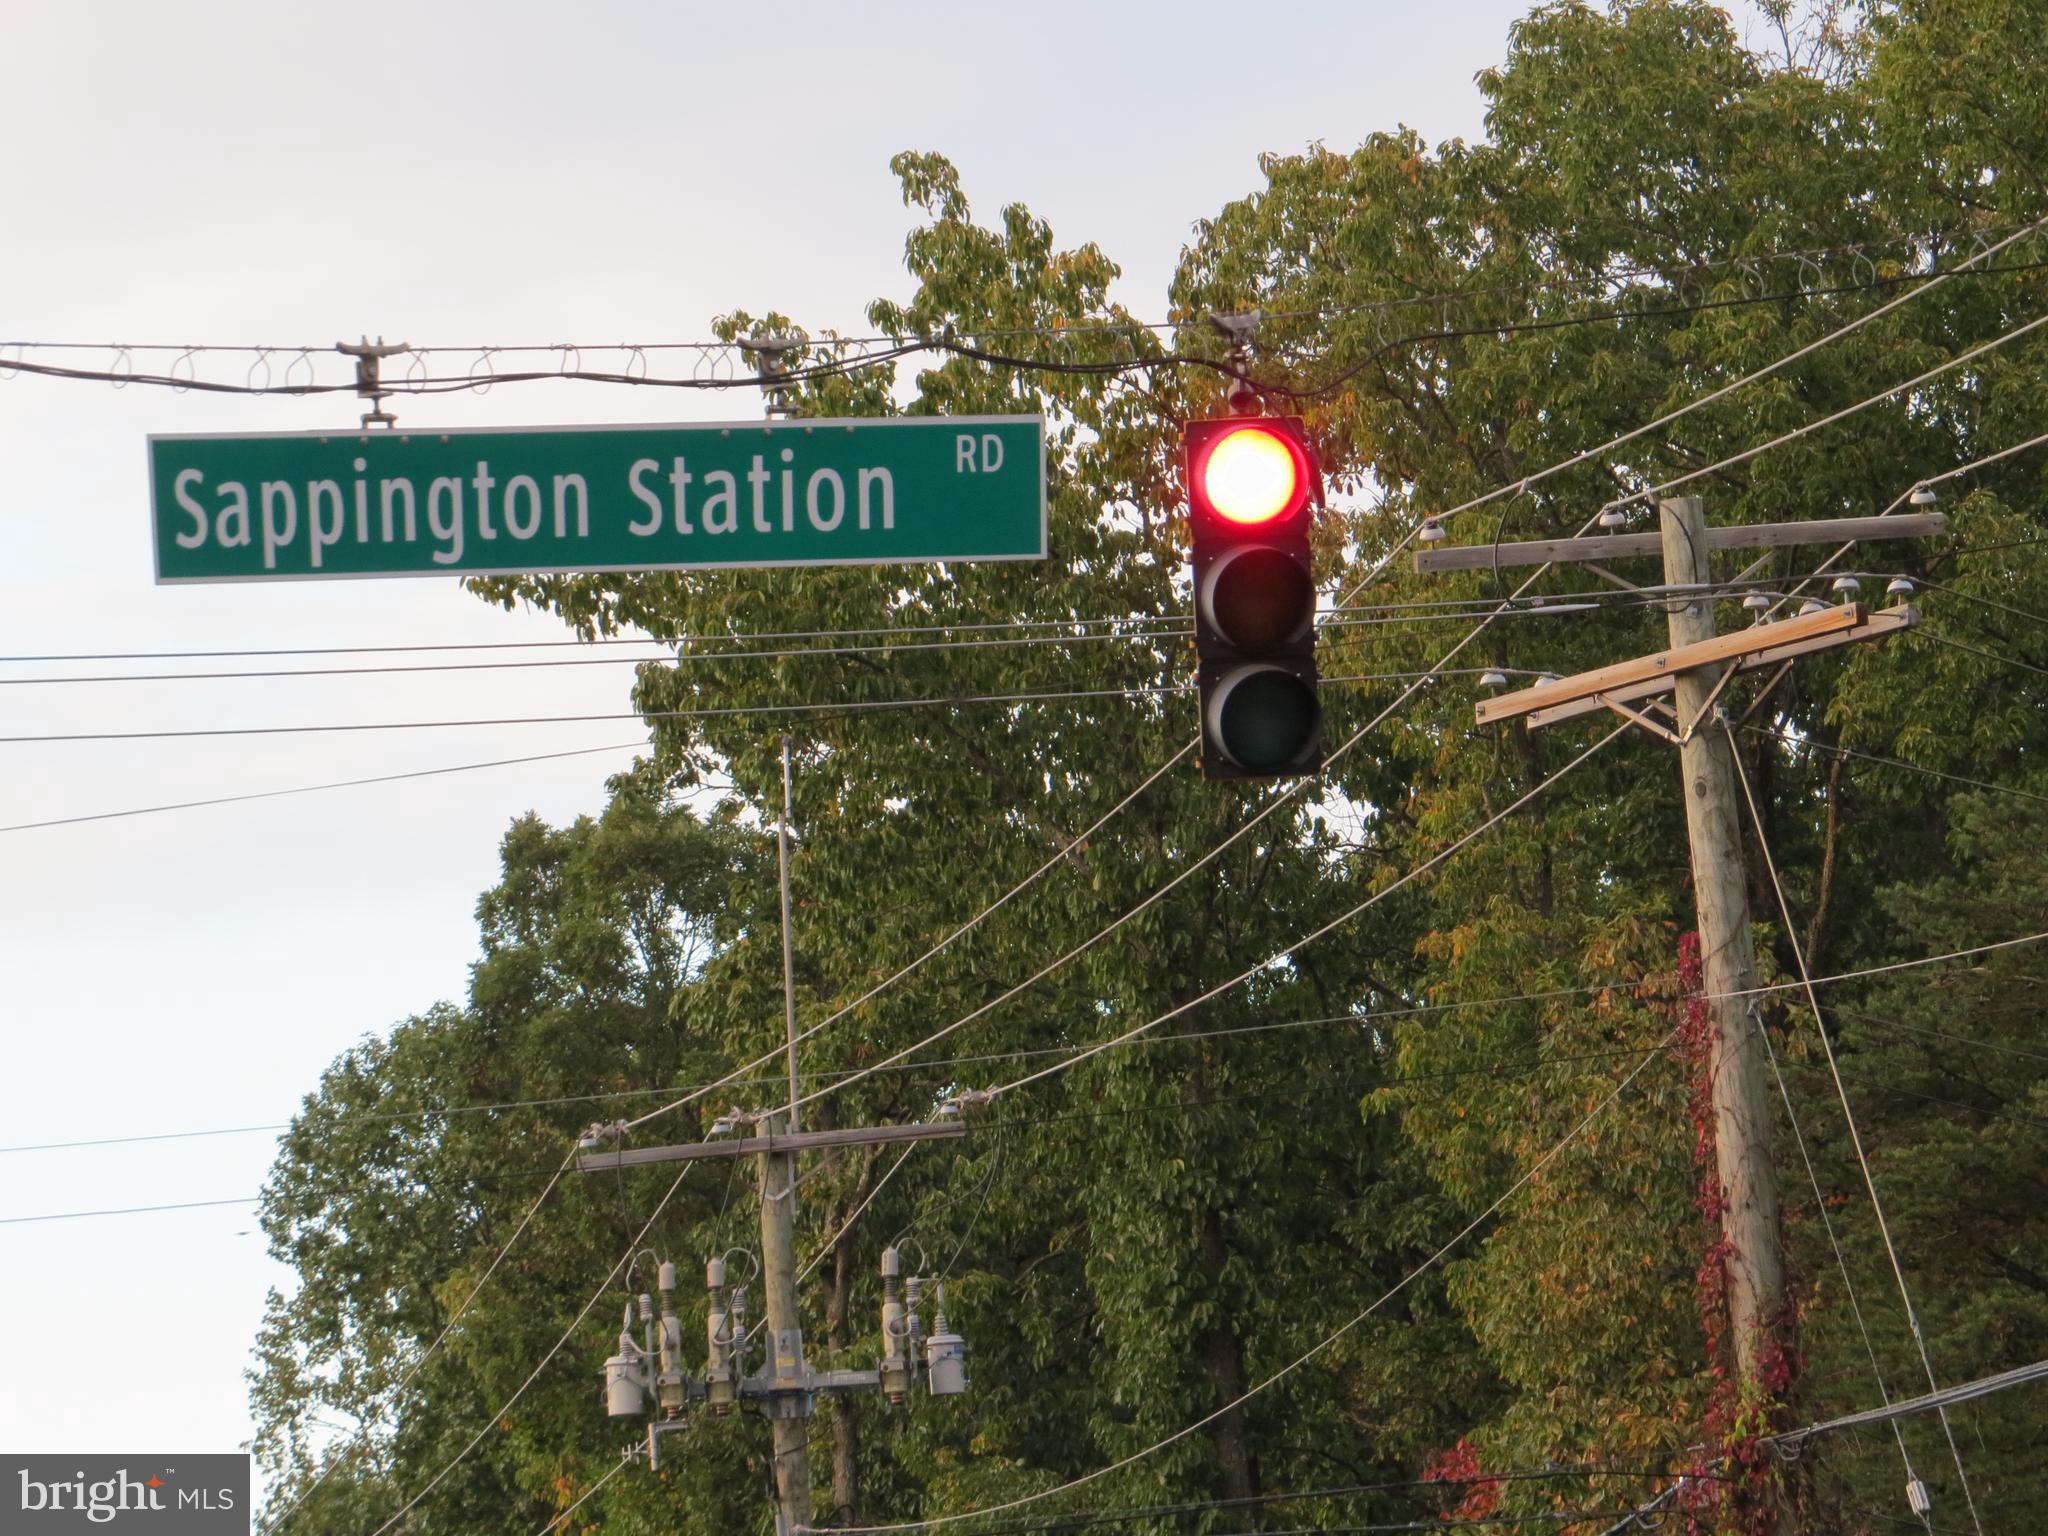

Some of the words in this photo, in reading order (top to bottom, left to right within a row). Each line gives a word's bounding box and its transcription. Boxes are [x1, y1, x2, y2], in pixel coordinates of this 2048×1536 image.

[174, 458, 589, 568] Sappington
[628, 448, 895, 537] Station
[956, 434, 1005, 473] RD
